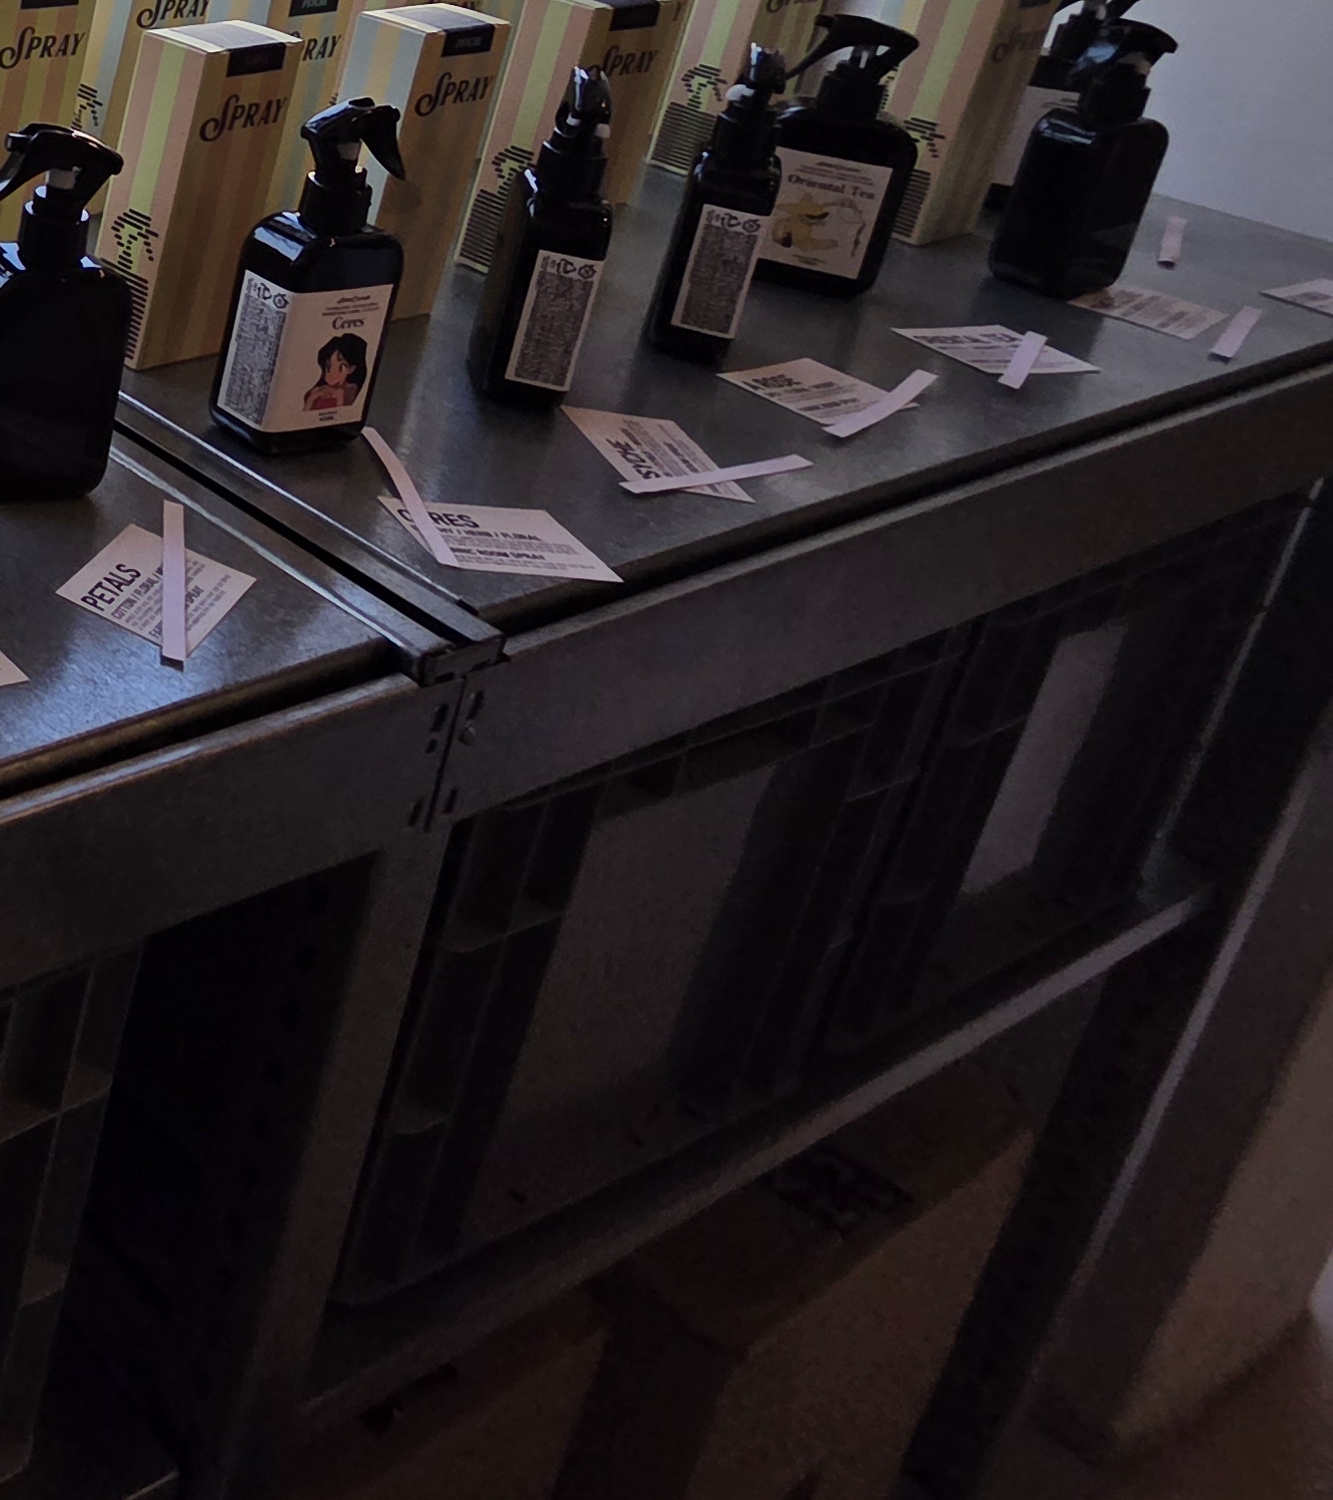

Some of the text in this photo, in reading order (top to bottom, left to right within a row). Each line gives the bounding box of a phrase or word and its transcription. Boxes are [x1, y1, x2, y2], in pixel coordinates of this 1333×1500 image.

[301, 33, 342, 62] RAY
[414, 71, 496, 117] SPRAY
[198, 92, 290, 144] SPRAY
[397, 508, 480, 529] CRES
[80, 563, 141, 612] PETALS
